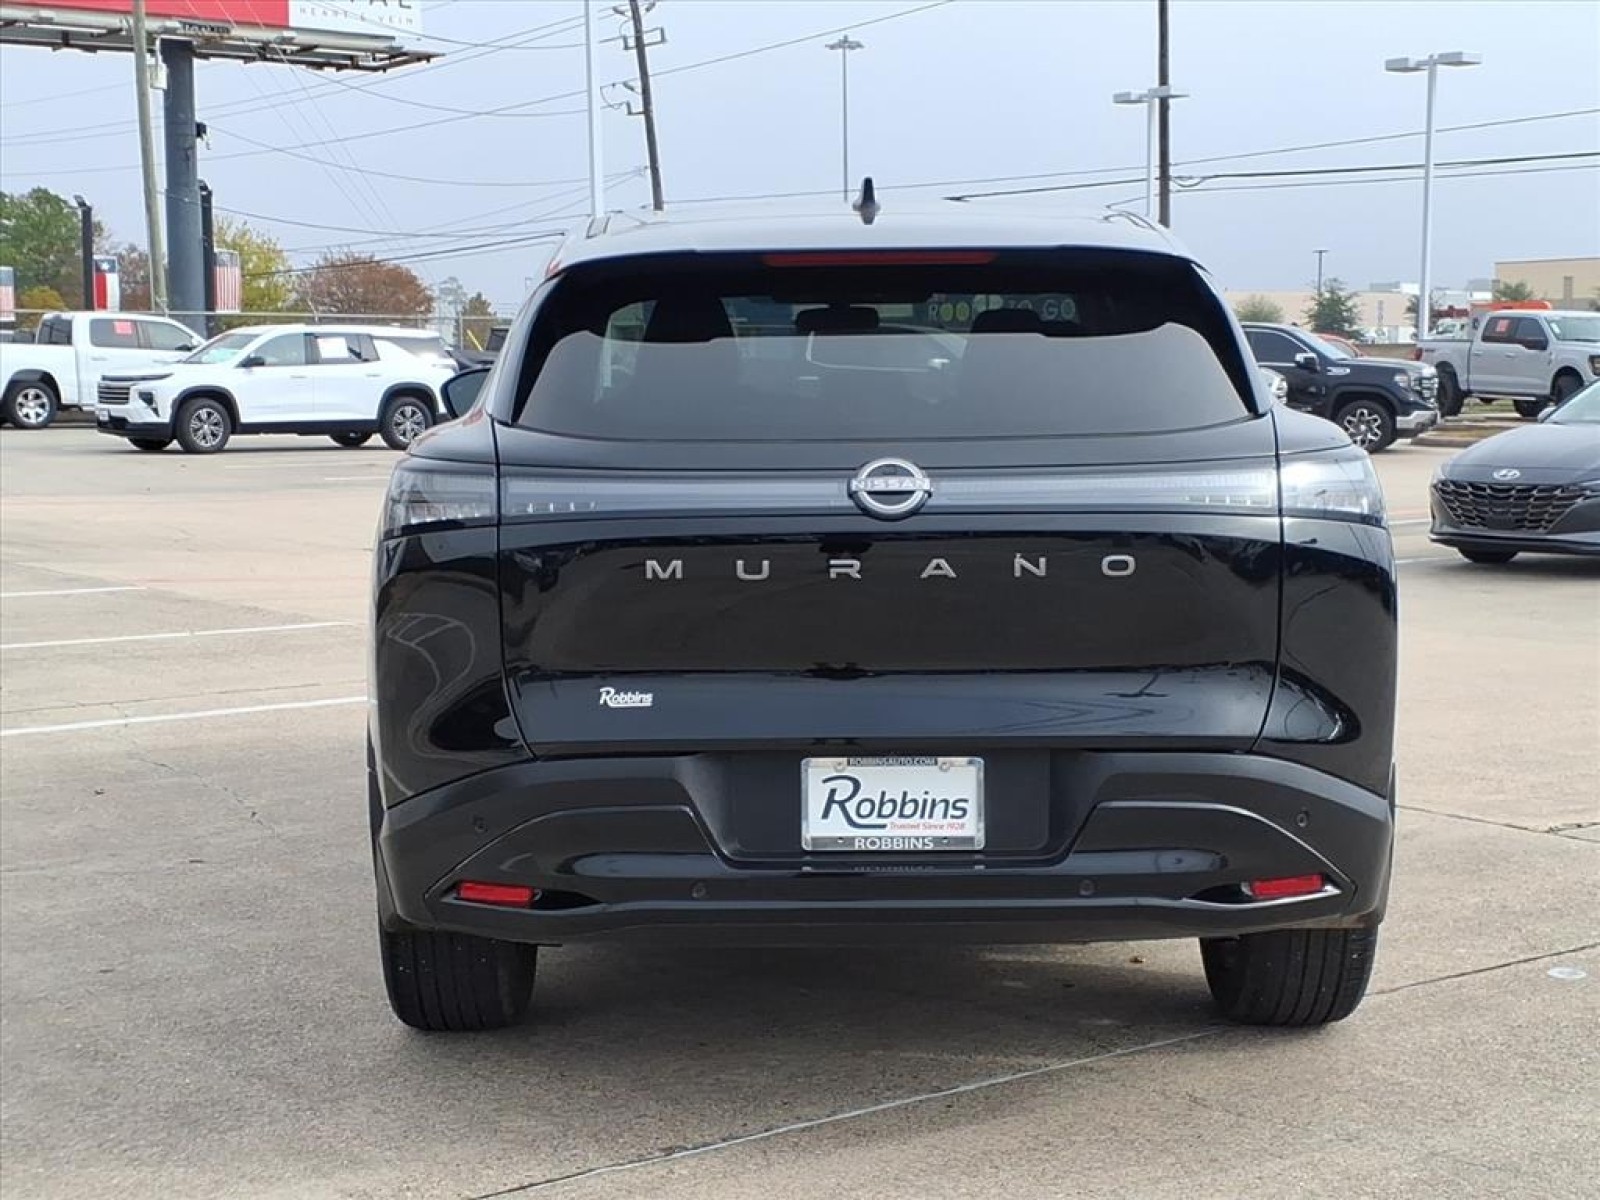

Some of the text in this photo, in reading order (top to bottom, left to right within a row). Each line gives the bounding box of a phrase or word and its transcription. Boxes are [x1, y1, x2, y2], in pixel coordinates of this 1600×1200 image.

[851, 478, 931, 491] NISSAN
[645, 554, 1136, 581] MURANO
[599, 686, 654, 708] Robbins
[821, 774, 970, 829] Robbins
[890, 822, 920, 831] Trusted
[922, 822, 945, 831] Since
[854, 837, 934, 849] ROBBINS
